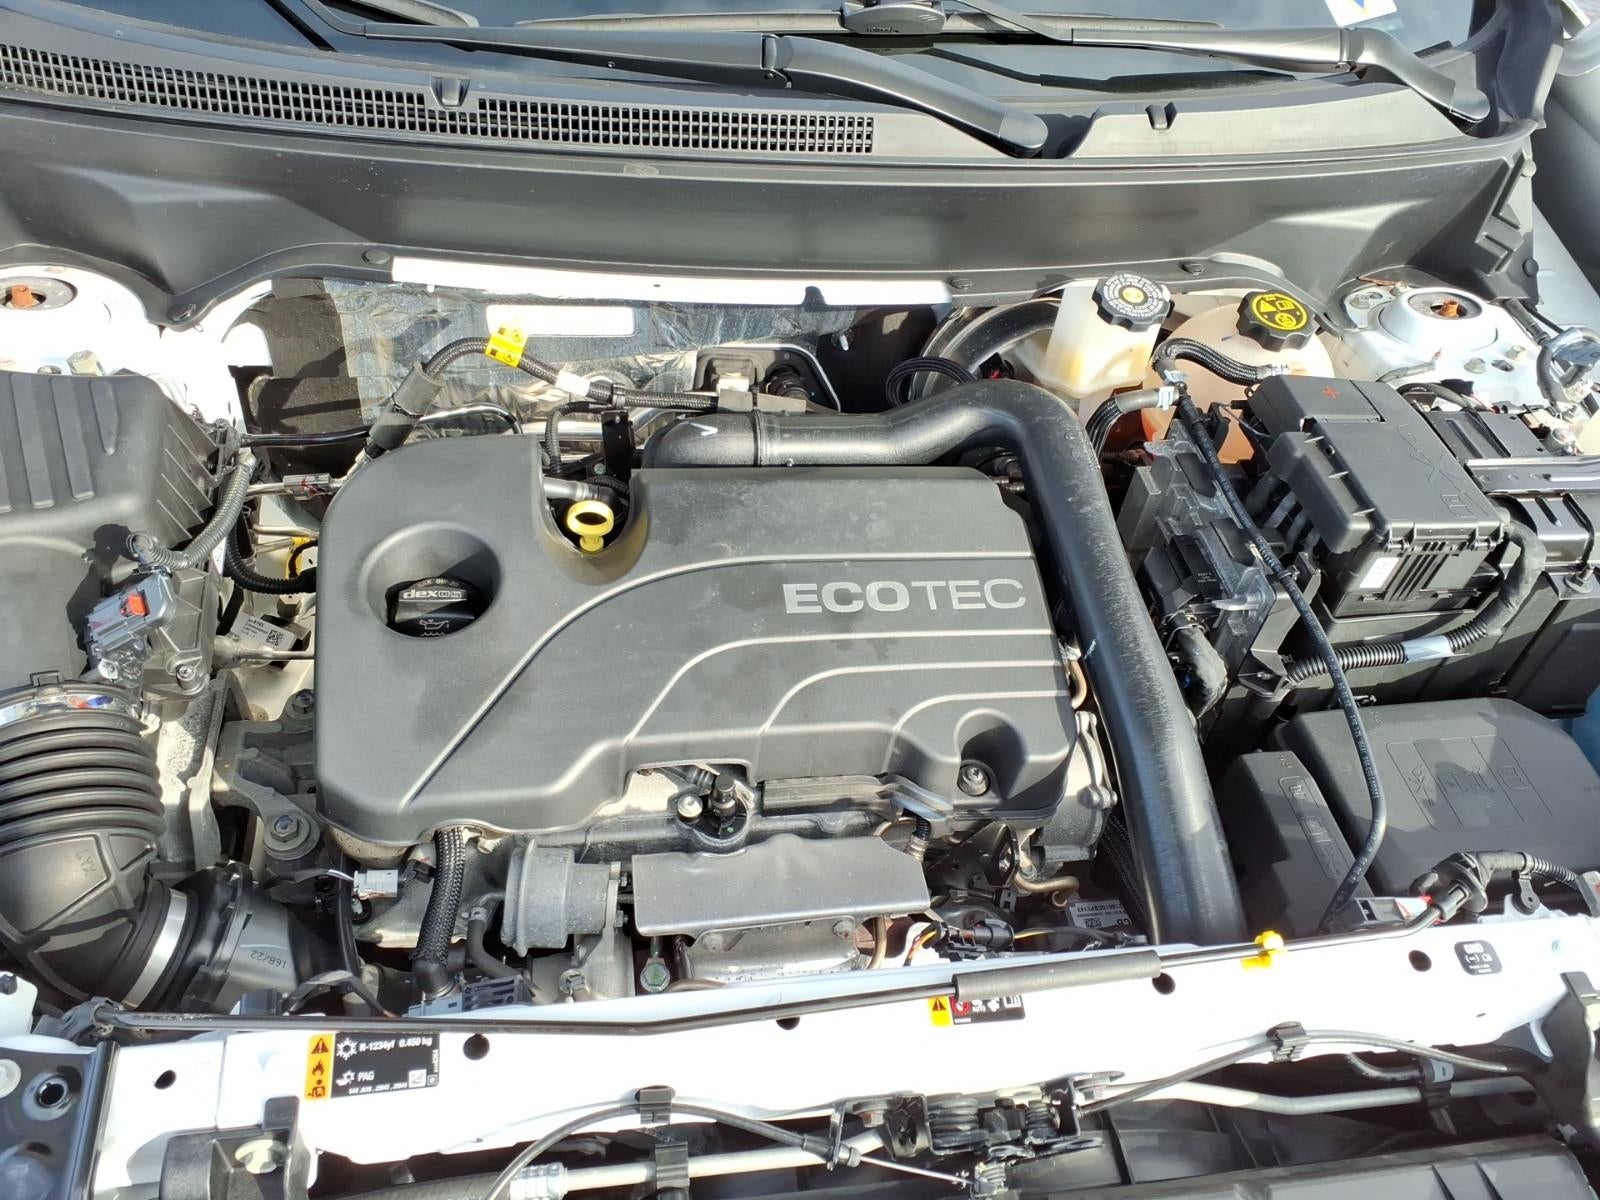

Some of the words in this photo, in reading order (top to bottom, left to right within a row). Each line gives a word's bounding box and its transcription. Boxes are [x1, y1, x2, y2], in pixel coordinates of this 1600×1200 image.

[403, 589, 462, 599] dexos
[783, 578, 1026, 613] ECOTEC
[358, 1070, 375, 1082] PAG
